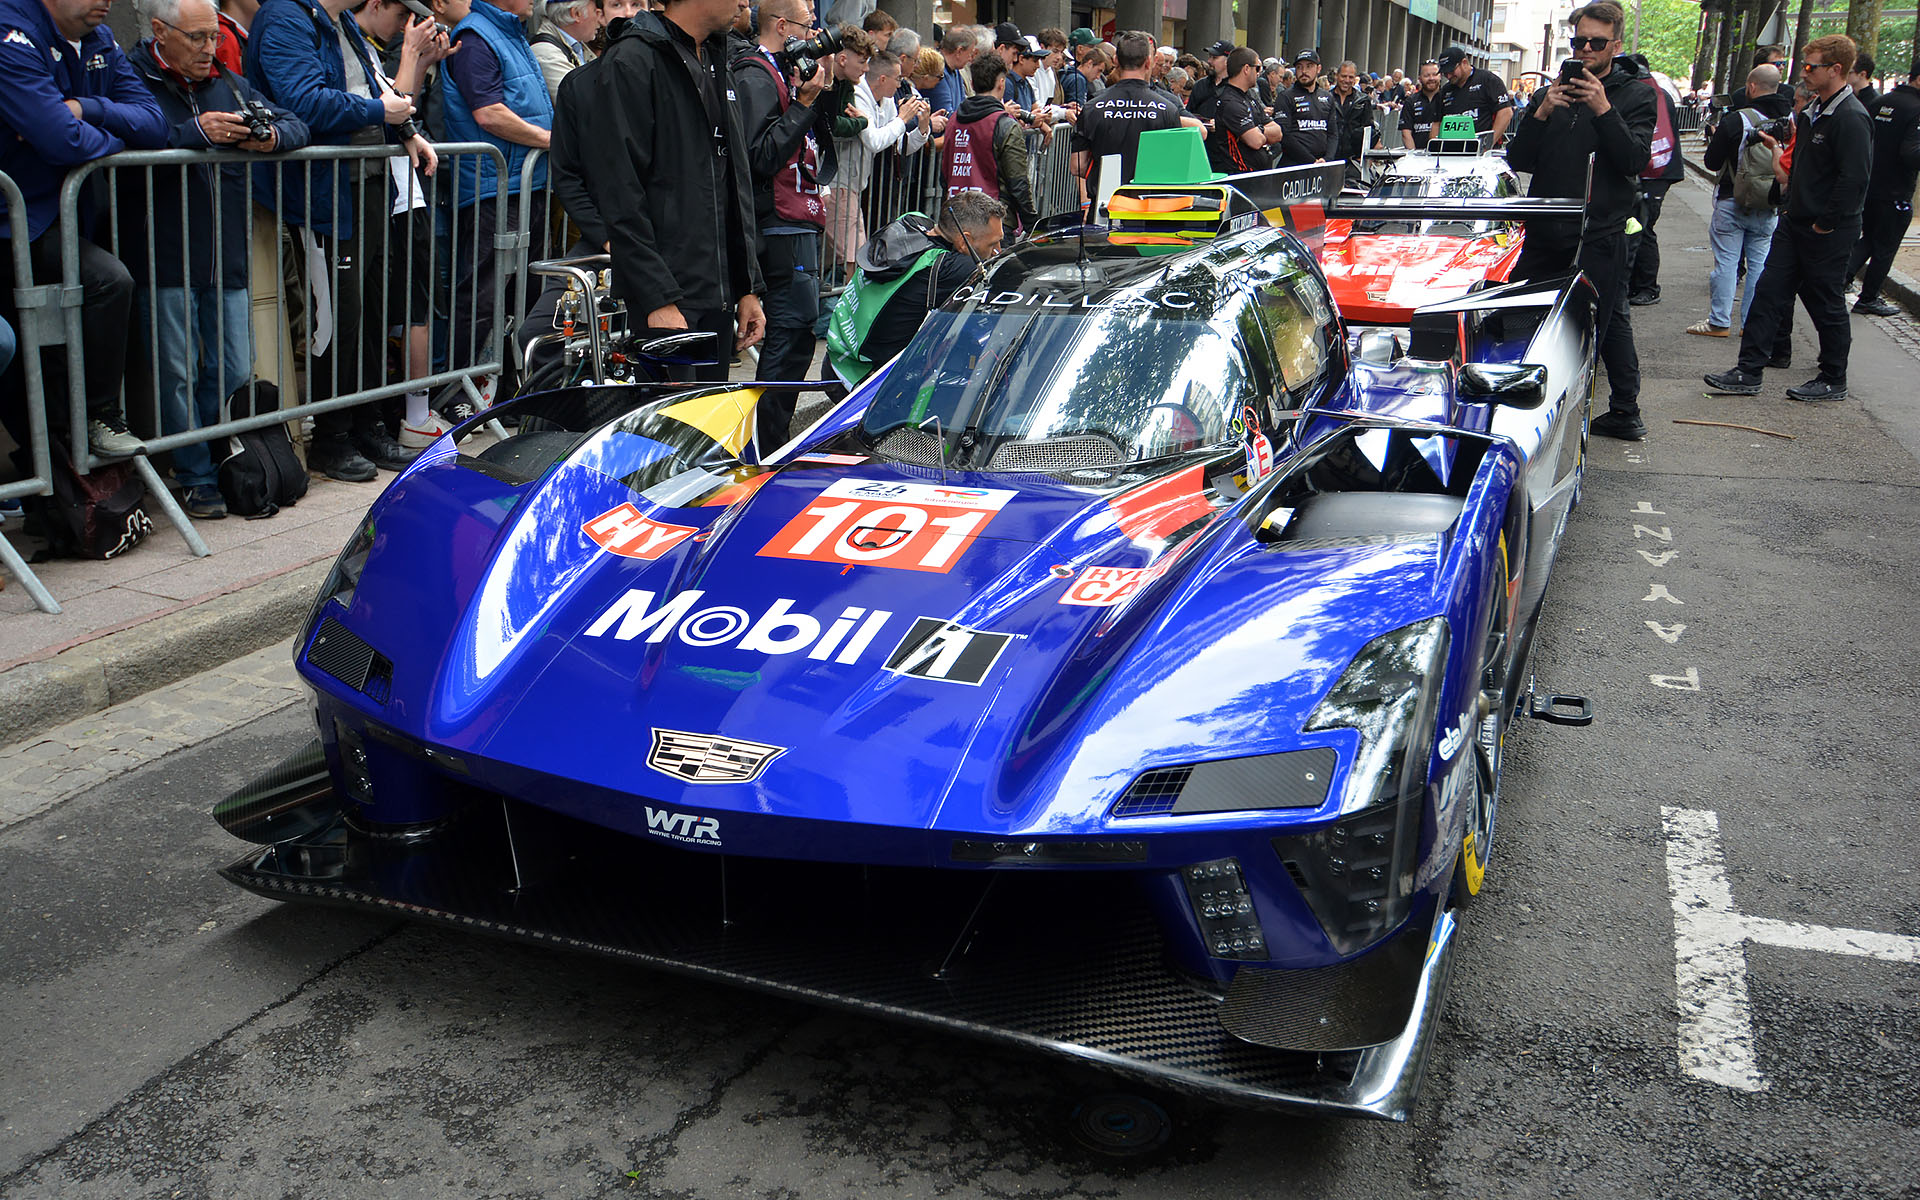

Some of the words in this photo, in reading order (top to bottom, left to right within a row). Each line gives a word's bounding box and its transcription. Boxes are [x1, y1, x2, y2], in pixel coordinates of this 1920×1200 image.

[1095, 99, 1167, 111] CADILLAC
[1104, 110, 1157, 119] RACING
[1443, 121, 1471, 132] SAFE
[953, 152, 972, 164] EDIA
[952, 165, 973, 177] RACK
[1282, 175, 1323, 201] CADILLAC
[953, 286, 1197, 309] CADILLAC
[590, 507, 691, 556] HY
[787, 501, 987, 569] 101
[583, 588, 894, 667] Mobil
[644, 805, 721, 840] WTR
[648, 828, 671, 839] WAYNE
[671, 833, 696, 844] TAYLOR
[696, 838, 722, 847] RACING
